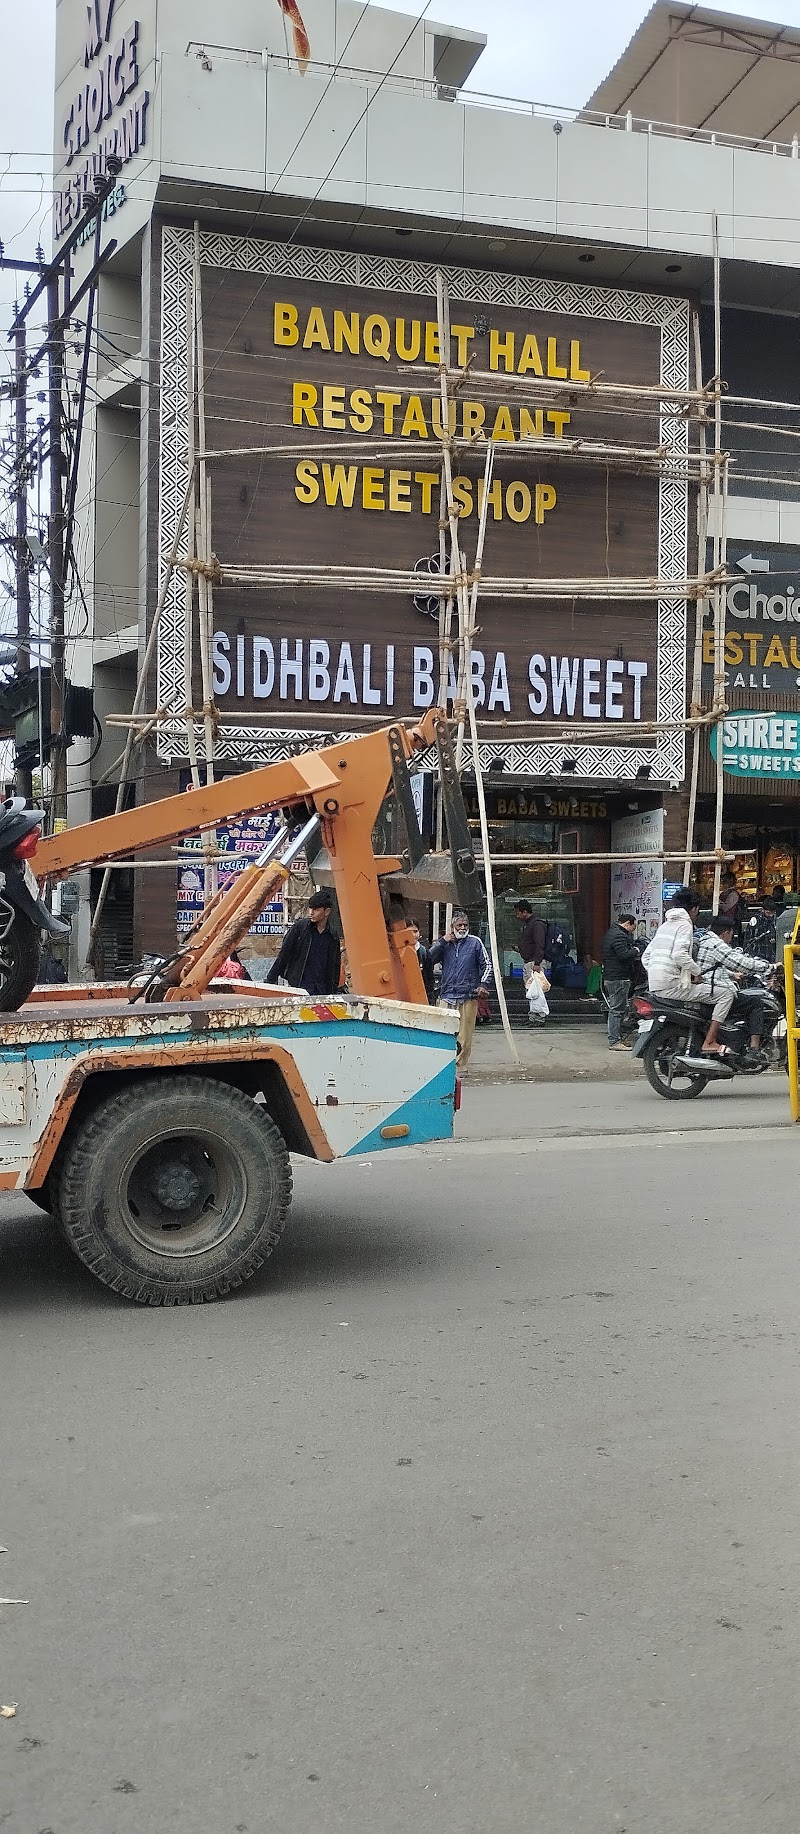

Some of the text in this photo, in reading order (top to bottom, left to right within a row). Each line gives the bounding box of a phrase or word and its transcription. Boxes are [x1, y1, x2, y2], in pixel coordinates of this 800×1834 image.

[63, 19, 140, 167] CHOICE
[273, 302, 591, 381] BANQUET HALL
[292, 382, 571, 442] RESTAURANT
[294, 460, 557, 525] SWEET SHOP
[212, 631, 648, 720] SIDHBALI BABA SWEET
[723, 718, 798, 750] SHREE
[497, 799, 538, 816] BABA
[549, 801, 607, 817] SWEETS
[177, 912, 194, 922] CAR
[178, 889, 196, 902] MY
